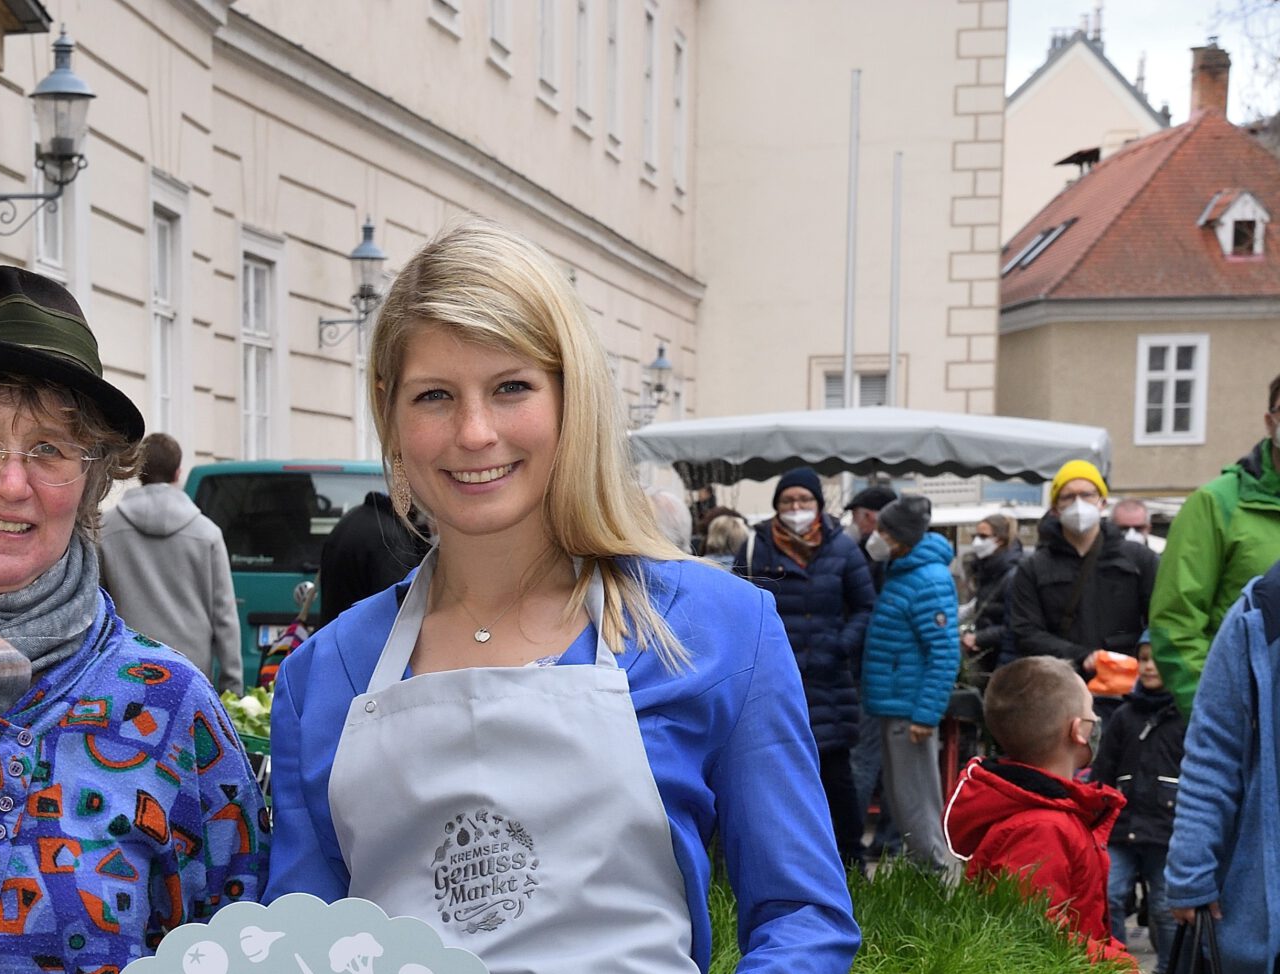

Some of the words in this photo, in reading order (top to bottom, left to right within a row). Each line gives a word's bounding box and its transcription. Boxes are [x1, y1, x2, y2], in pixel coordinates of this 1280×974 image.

[450, 842, 510, 866] KREMSER
[434, 851, 527, 900] Genuss
[449, 874, 519, 907] Markt
